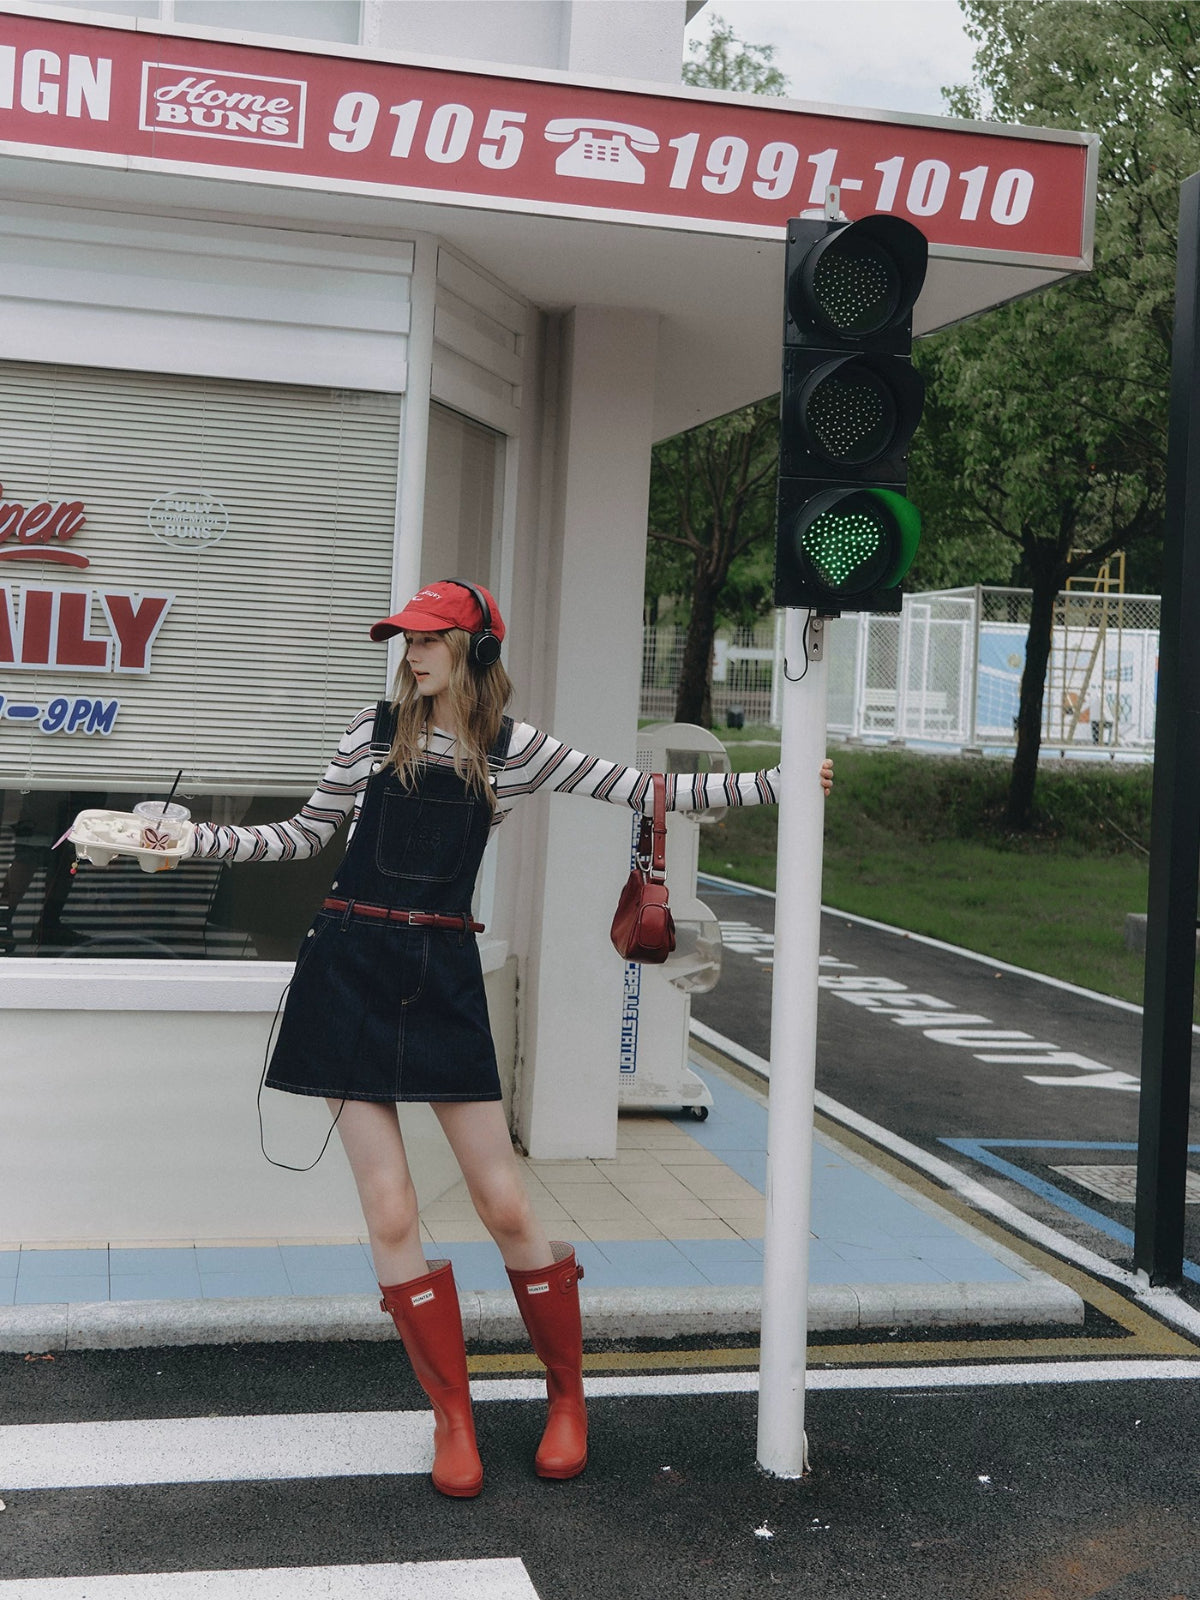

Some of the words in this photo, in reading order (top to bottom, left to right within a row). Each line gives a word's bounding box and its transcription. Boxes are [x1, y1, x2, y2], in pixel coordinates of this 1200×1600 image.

[153, 77, 294, 114] Home
[155, 102, 290, 136] BUNS
[328, 91, 527, 170] 9105
[668, 132, 1035, 225] 1991-1010
[0, 483, 87, 545] pen
[156, 513, 221, 525] HOMEMADE
[164, 501, 213, 514] FULLY
[164, 524, 212, 539] BUNS
[619, 1018, 639, 1074] STATION
[818, 975, 1142, 1092] BEAUTY
[412, 1291, 433, 1303] HUNTER
